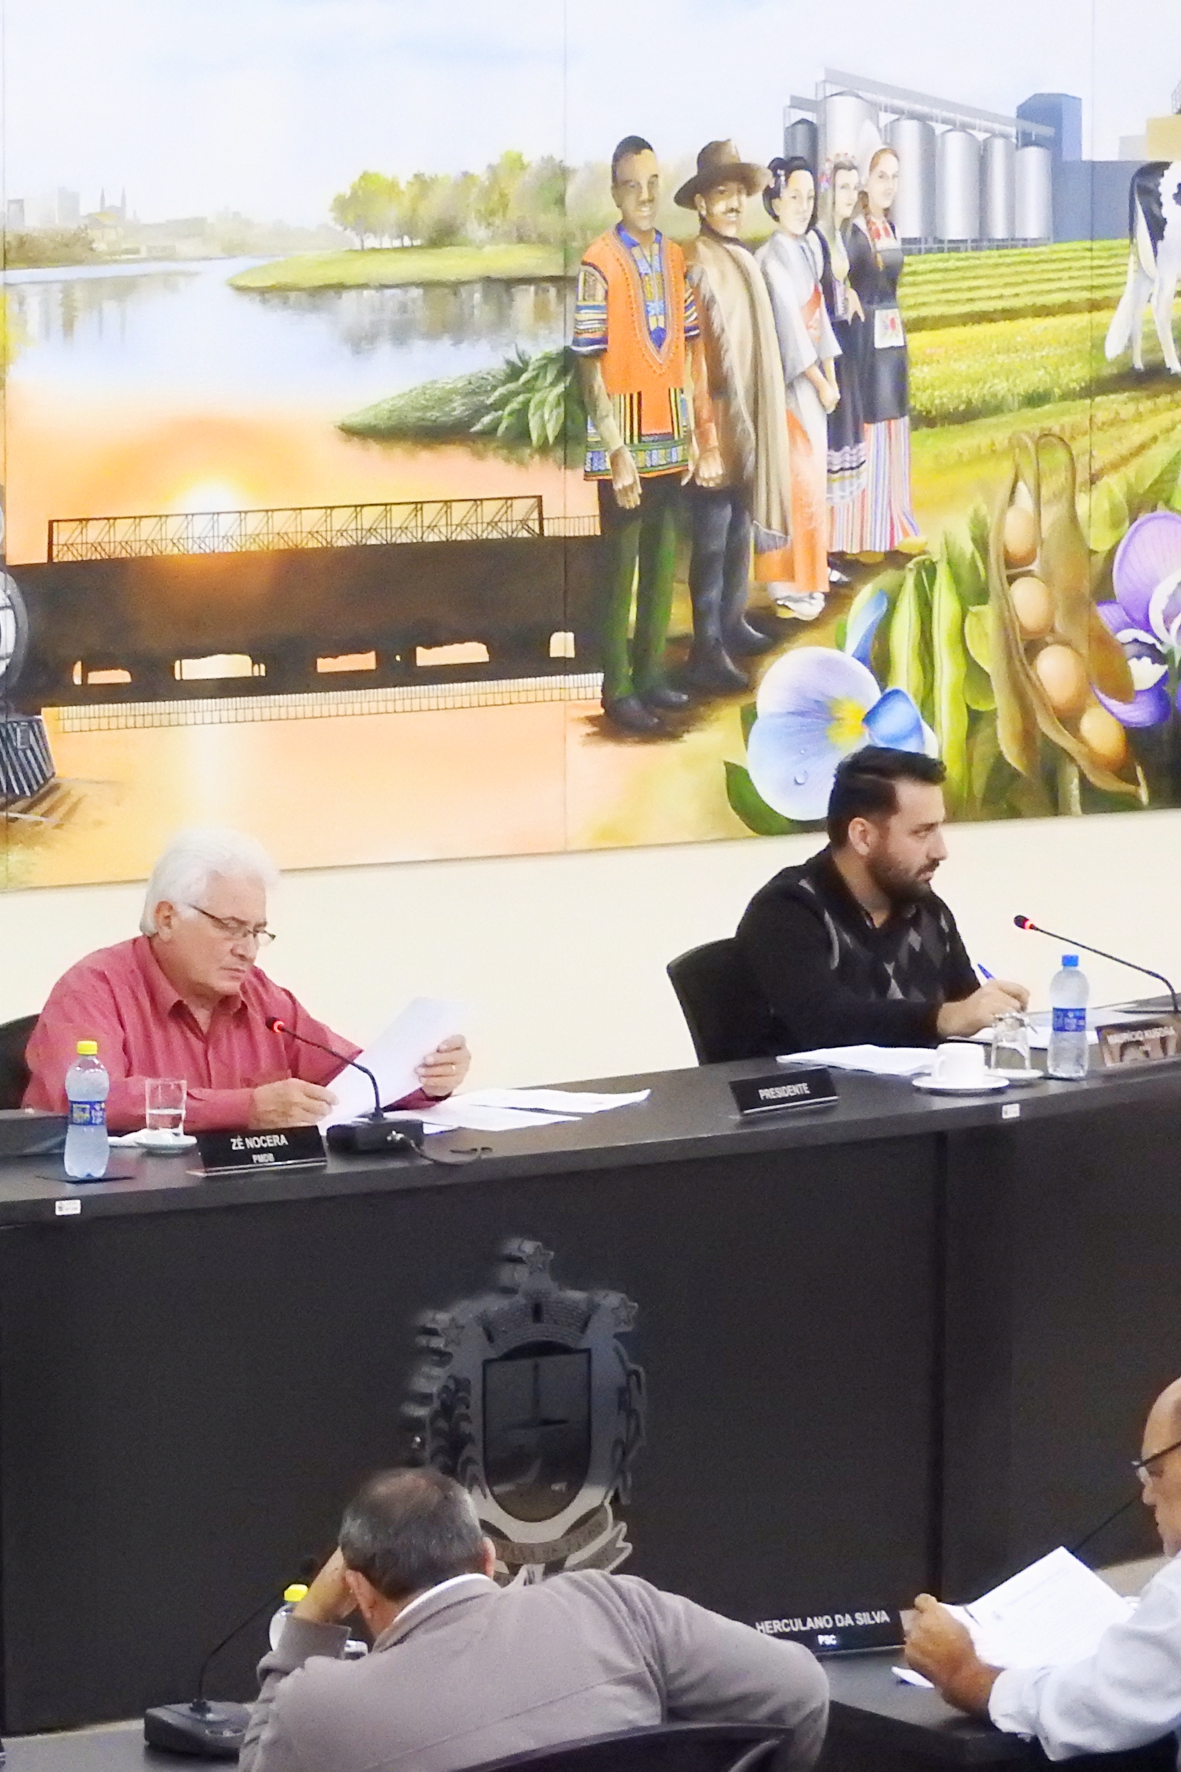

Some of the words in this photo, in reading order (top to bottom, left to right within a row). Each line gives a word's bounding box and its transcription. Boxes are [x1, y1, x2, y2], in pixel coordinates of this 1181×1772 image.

[758, 1082, 811, 1100] PRESIDENTE
[230, 1135, 245, 1150] ZÉ
[245, 1134, 289, 1149] NOCERA
[755, 1615, 833, 1634] HERCULANO
[834, 1613, 854, 1627] DA
[855, 1609, 891, 1625] SILVA
[817, 1635, 837, 1645] PSC
